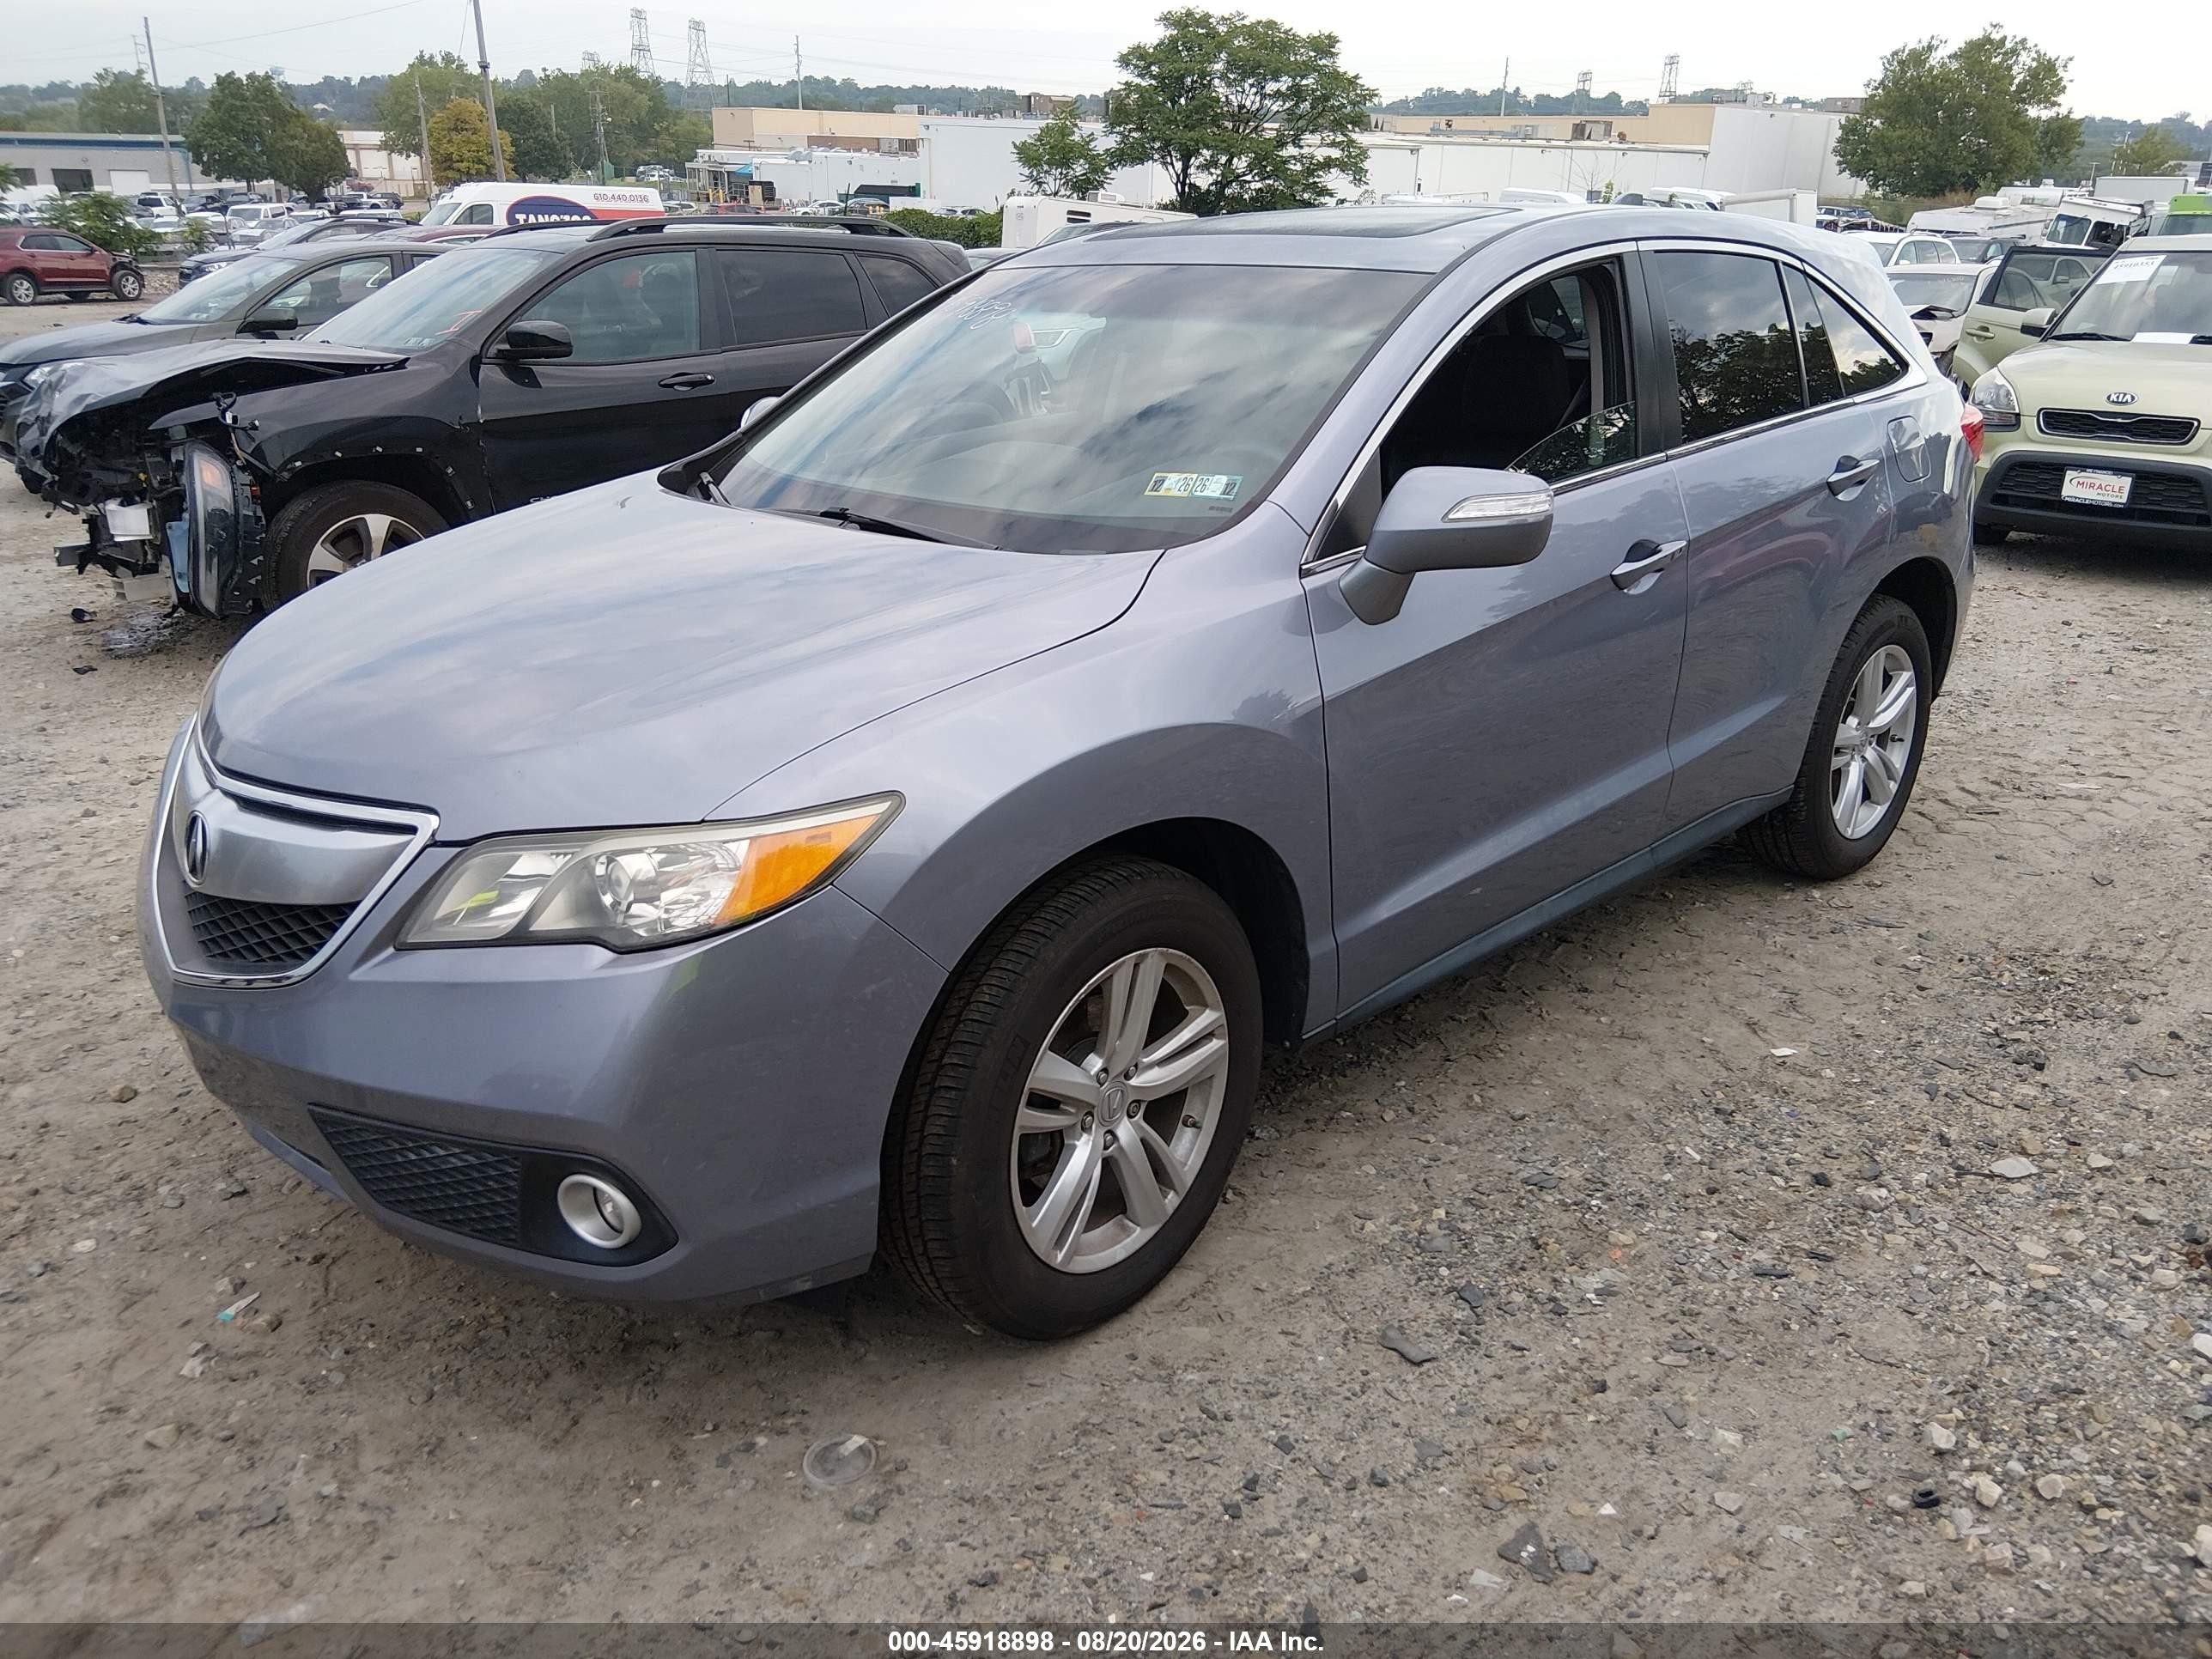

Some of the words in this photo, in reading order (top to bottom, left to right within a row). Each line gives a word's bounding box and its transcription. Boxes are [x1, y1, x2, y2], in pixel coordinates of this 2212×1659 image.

[593, 193, 650, 203] 610.440.0136
[2110, 393, 2132, 403] KIA
[1149, 478, 1165, 493] 12
[1178, 477, 1194, 492] 26
[1194, 477, 1210, 493] 26
[1220, 482, 1237, 496] 12
[2076, 480, 2125, 495] MIRACLE
